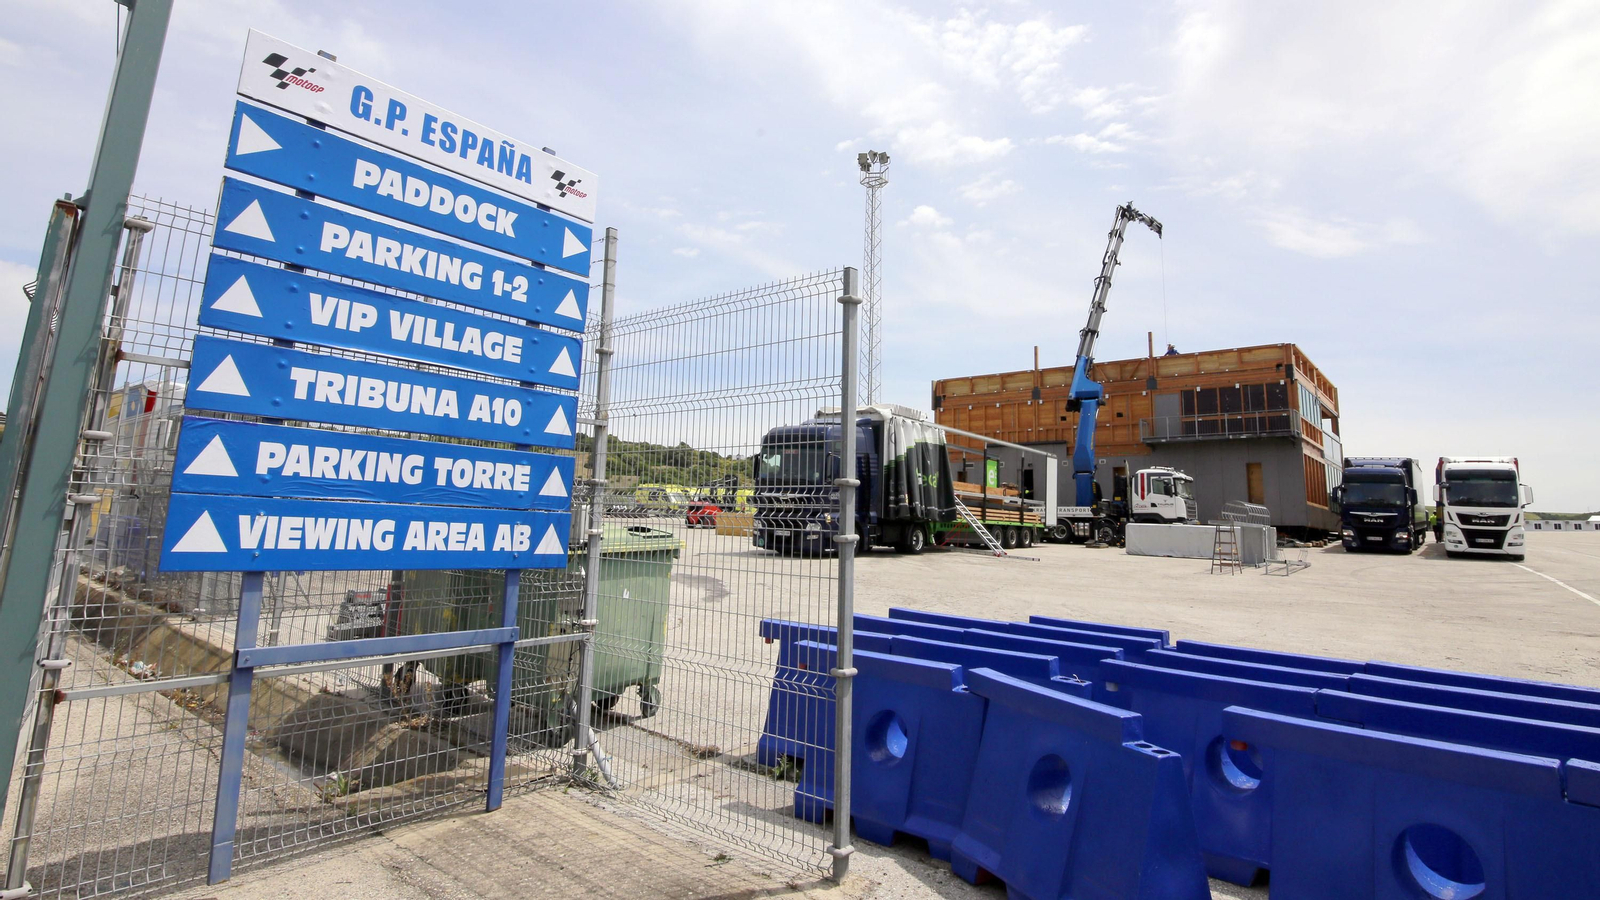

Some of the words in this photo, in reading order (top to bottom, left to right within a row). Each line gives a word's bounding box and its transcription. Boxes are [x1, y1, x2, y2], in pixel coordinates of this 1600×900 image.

[349, 86, 409, 136] G.P.
[421, 114, 532, 185] ESPAÑA
[353, 159, 519, 238] PADDOCK
[320, 222, 484, 291] PARKING
[492, 270, 529, 303] 1-2
[310, 293, 378, 333] VIP
[389, 310, 523, 364] VILLAGE
[290, 367, 459, 420] TRIBUNA
[468, 395, 523, 427] A10
[255, 442, 425, 485] PARKING
[434, 457, 531, 492] TORRE
[238, 513, 396, 552] VIEWING
[402, 521, 486, 552] AREA
[493, 524, 531, 552] AB
